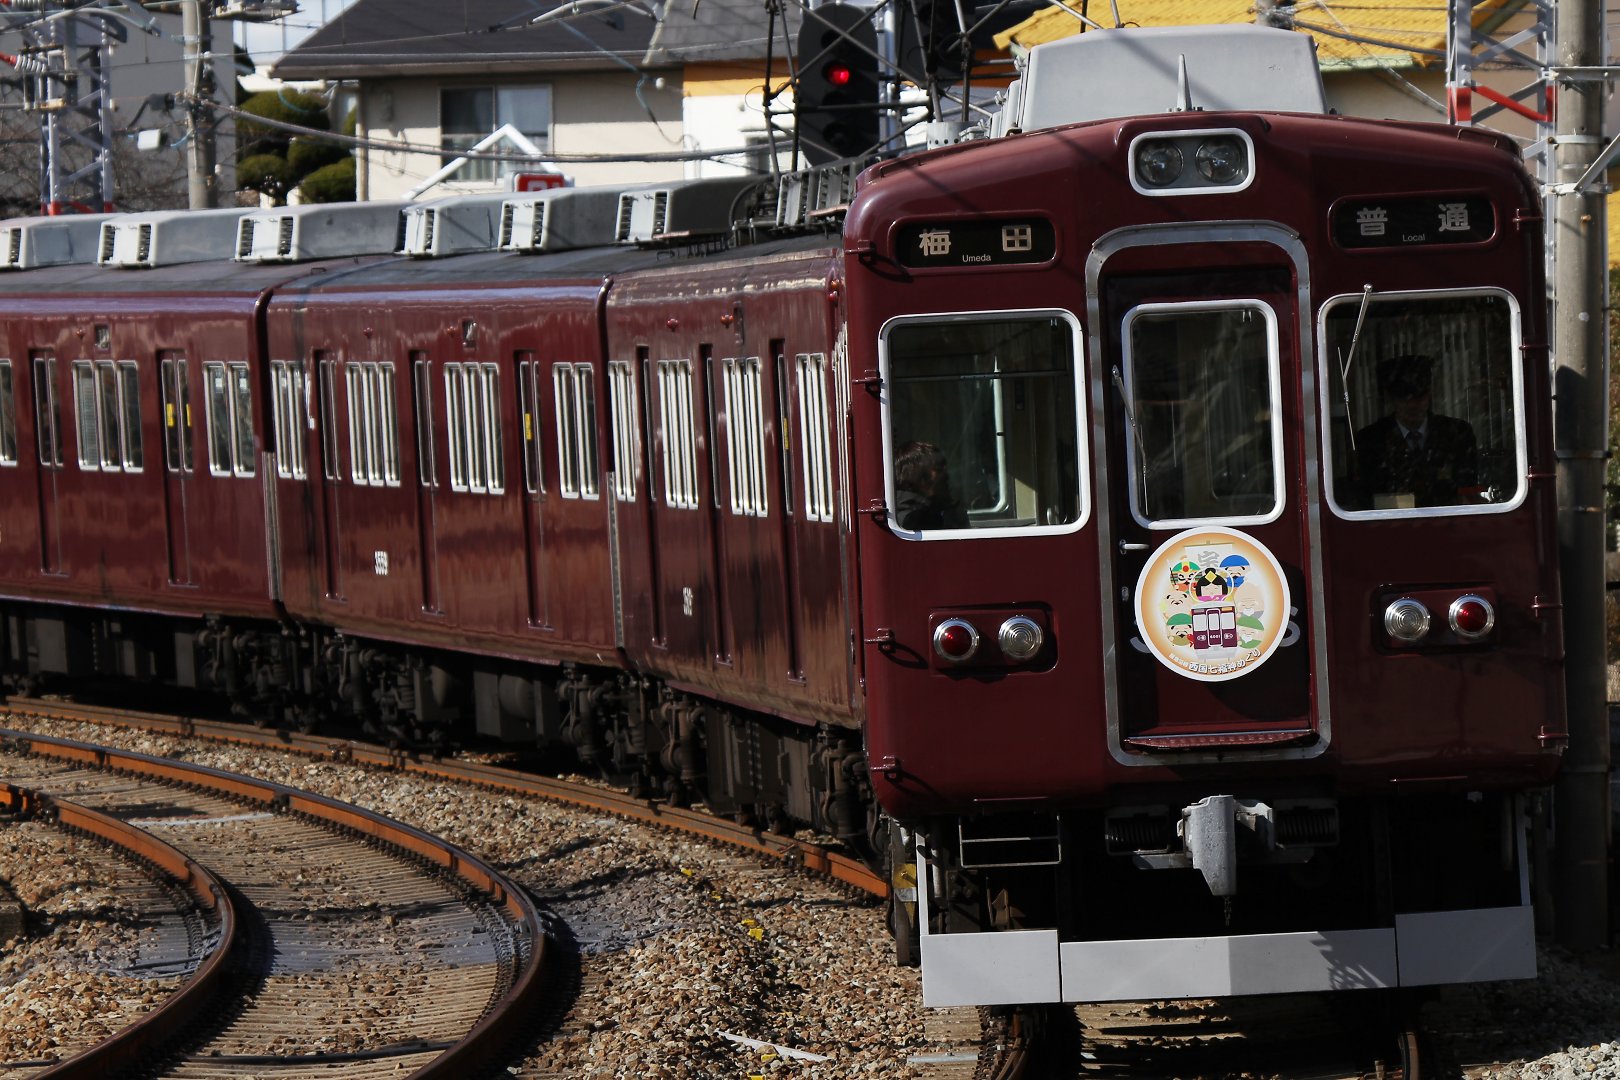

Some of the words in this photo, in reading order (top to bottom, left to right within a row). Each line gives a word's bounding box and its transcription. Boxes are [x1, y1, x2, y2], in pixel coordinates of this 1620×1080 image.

[1357, 203, 1470, 236] 普通
[919, 225, 1032, 256] 梅田
[1402, 233, 1426, 242] Local
[962, 253, 992, 263] Umeda
